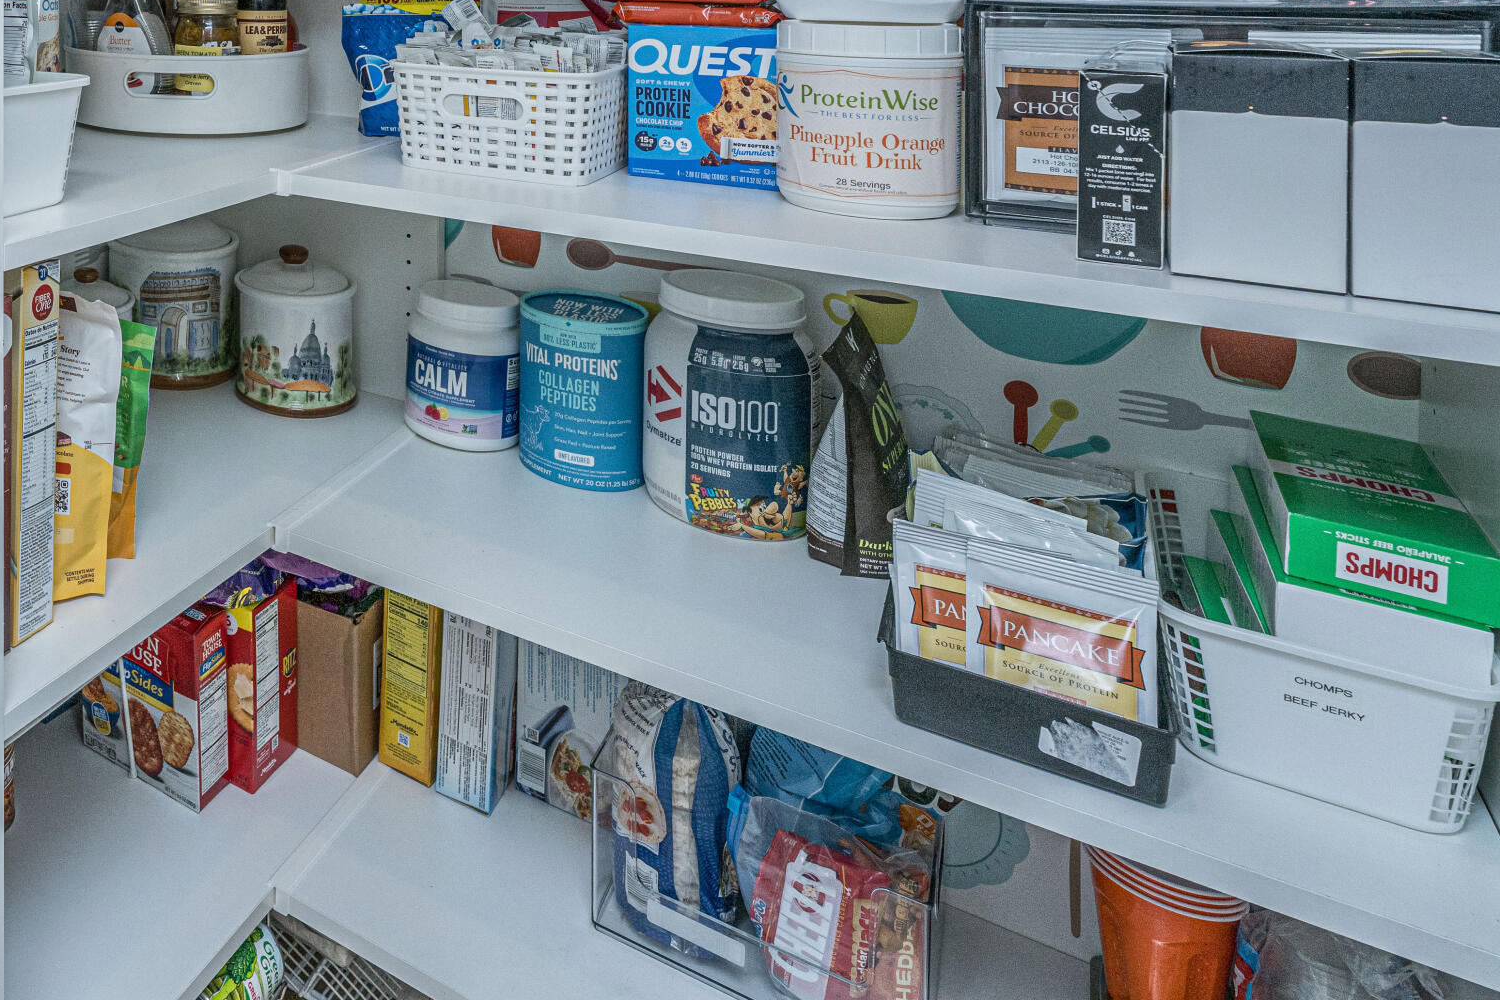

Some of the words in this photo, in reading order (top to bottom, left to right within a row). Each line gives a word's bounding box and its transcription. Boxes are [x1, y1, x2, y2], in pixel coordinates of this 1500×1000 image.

[12, 2, 27, 10] Facts
[109, 35, 131, 46] Butter
[628, 38, 777, 79] QUEST
[636, 86, 690, 102] PROTEIN
[800, 84, 939, 112] ProteinWise
[636, 101, 690, 119] COOKIE
[820, 110, 838, 118] THE
[841, 111, 866, 119] BEST
[636, 118, 668, 126] CHOCOLATE
[1091, 125, 1150, 137] CELSIUS
[790, 125, 874, 154] Pineapple
[881, 132, 946, 154] Orange
[1020, 130, 1059, 139] SOURCE
[732, 147, 775, 157] Yummier!
[810, 147, 858, 168] Fruit
[865, 151, 923, 171] Drink
[835, 176, 848, 186] 28
[850, 179, 892, 191] Servings
[35, 293, 51, 303] FIBER
[591, 304, 624, 314] WITH
[60, 345, 80, 357] Story
[571, 339, 598, 350] PLASTIC
[526, 341, 550, 366] VITAL
[554, 353, 619, 381] PROTEINS
[693, 353, 708, 366] 25g
[415, 358, 467, 397] CALM
[538, 370, 600, 396] COLLAGEN
[540, 386, 597, 412] PEPTIDES
[691, 389, 779, 436] ISO100
[646, 419, 682, 447] Dymatize
[691, 424, 779, 443] HYDROLYZED
[557, 453, 591, 465] UNFLAVORED
[691, 444, 718, 458] PROTEIN
[719, 450, 744, 463] POWDER
[699, 465, 731, 478] SERVINGS
[707, 456, 724, 466] WHEY
[725, 459, 753, 471] PROTEIN
[753, 463, 778, 474] ISOLATE
[558, 473, 572, 484] NET
[573, 476, 585, 485] WT
[595, 479, 606, 488] OZ
[1296, 463, 1436, 504] CHOMPS
[690, 482, 730, 499] FRUITY
[692, 493, 737, 511] PEBBLES
[1335, 529, 1366, 544] STICKS
[1372, 537, 1393, 551] BEEF
[1345, 551, 1438, 595] CHOMPS
[417, 618, 429, 628] 140
[202, 629, 222, 650] TOWN
[1003, 620, 1120, 667] PANCAKE
[202, 638, 223, 662] HOUSE
[282, 648, 297, 678] RITZ
[1038, 662, 1082, 680] Excellent
[1002, 659, 1045, 680] SOURCE
[1049, 673, 1064, 685] OF
[1069, 679, 1119, 701] PROTEIN
[1294, 675, 1354, 699] CHOMPS
[1283, 692, 1319, 711] BEEF
[1321, 704, 1366, 722] JERKY
[262, 941, 279, 984] Green
